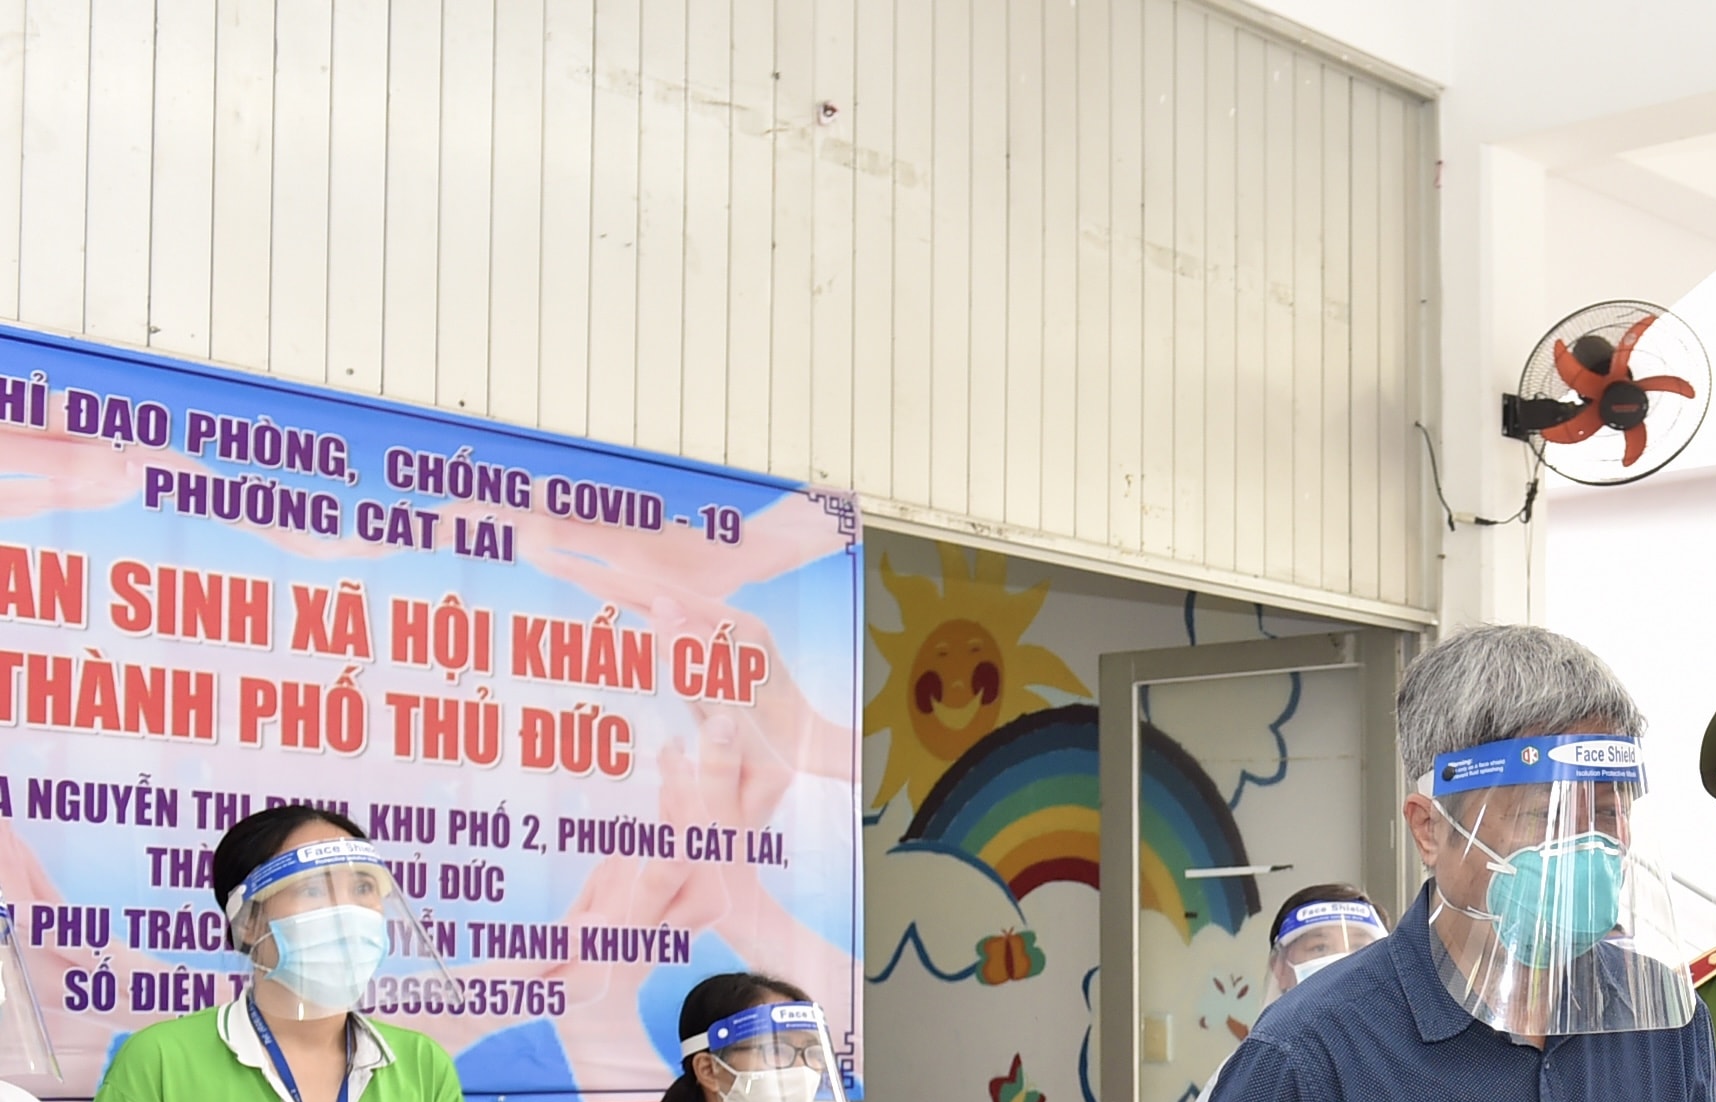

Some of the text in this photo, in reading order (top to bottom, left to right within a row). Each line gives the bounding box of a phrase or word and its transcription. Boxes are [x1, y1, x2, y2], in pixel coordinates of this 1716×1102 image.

[65, 389, 169, 450] ĐẠO
[186, 415, 357, 486] PHÒNG,
[386, 445, 532, 510] CHỐNG
[545, 475, 663, 531] COVID
[675, 515, 690, 527] -
[701, 505, 741, 545] 19
[144, 465, 515, 563] PHƯỜNG CÁT LÁI
[0, 544, 766, 705] AN SINH XÃ HỘI KHẨN CẤP
[0, 647, 632, 777] THÀNH PHỐ THỦ ĐỨC
[1575, 745, 1636, 763] Face Shield
[27, 773, 178, 828] NGUYỄN
[370, 803, 436, 845] KHU
[448, 801, 511, 850] PHỐ
[522, 814, 547, 854] 2,
[557, 814, 675, 859] PHƯỜNG
[685, 823, 736, 862] CÁT
[747, 825, 789, 869] LÁI,
[304, 844, 340, 858] Face
[146, 843, 214, 889] THÀ
[384, 853, 427, 899] HỦ
[439, 859, 505, 902] ĐỨC
[31, 904, 110, 956] PHỤ
[468, 921, 569, 960] THANH
[580, 924, 690, 964] KHUYÊN
[1302, 902, 1366, 918] Face Shield
[65, 957, 115, 1011] SỐ
[130, 965, 215, 1018] ĐIỆN
[780, 1009, 807, 1019] Face
